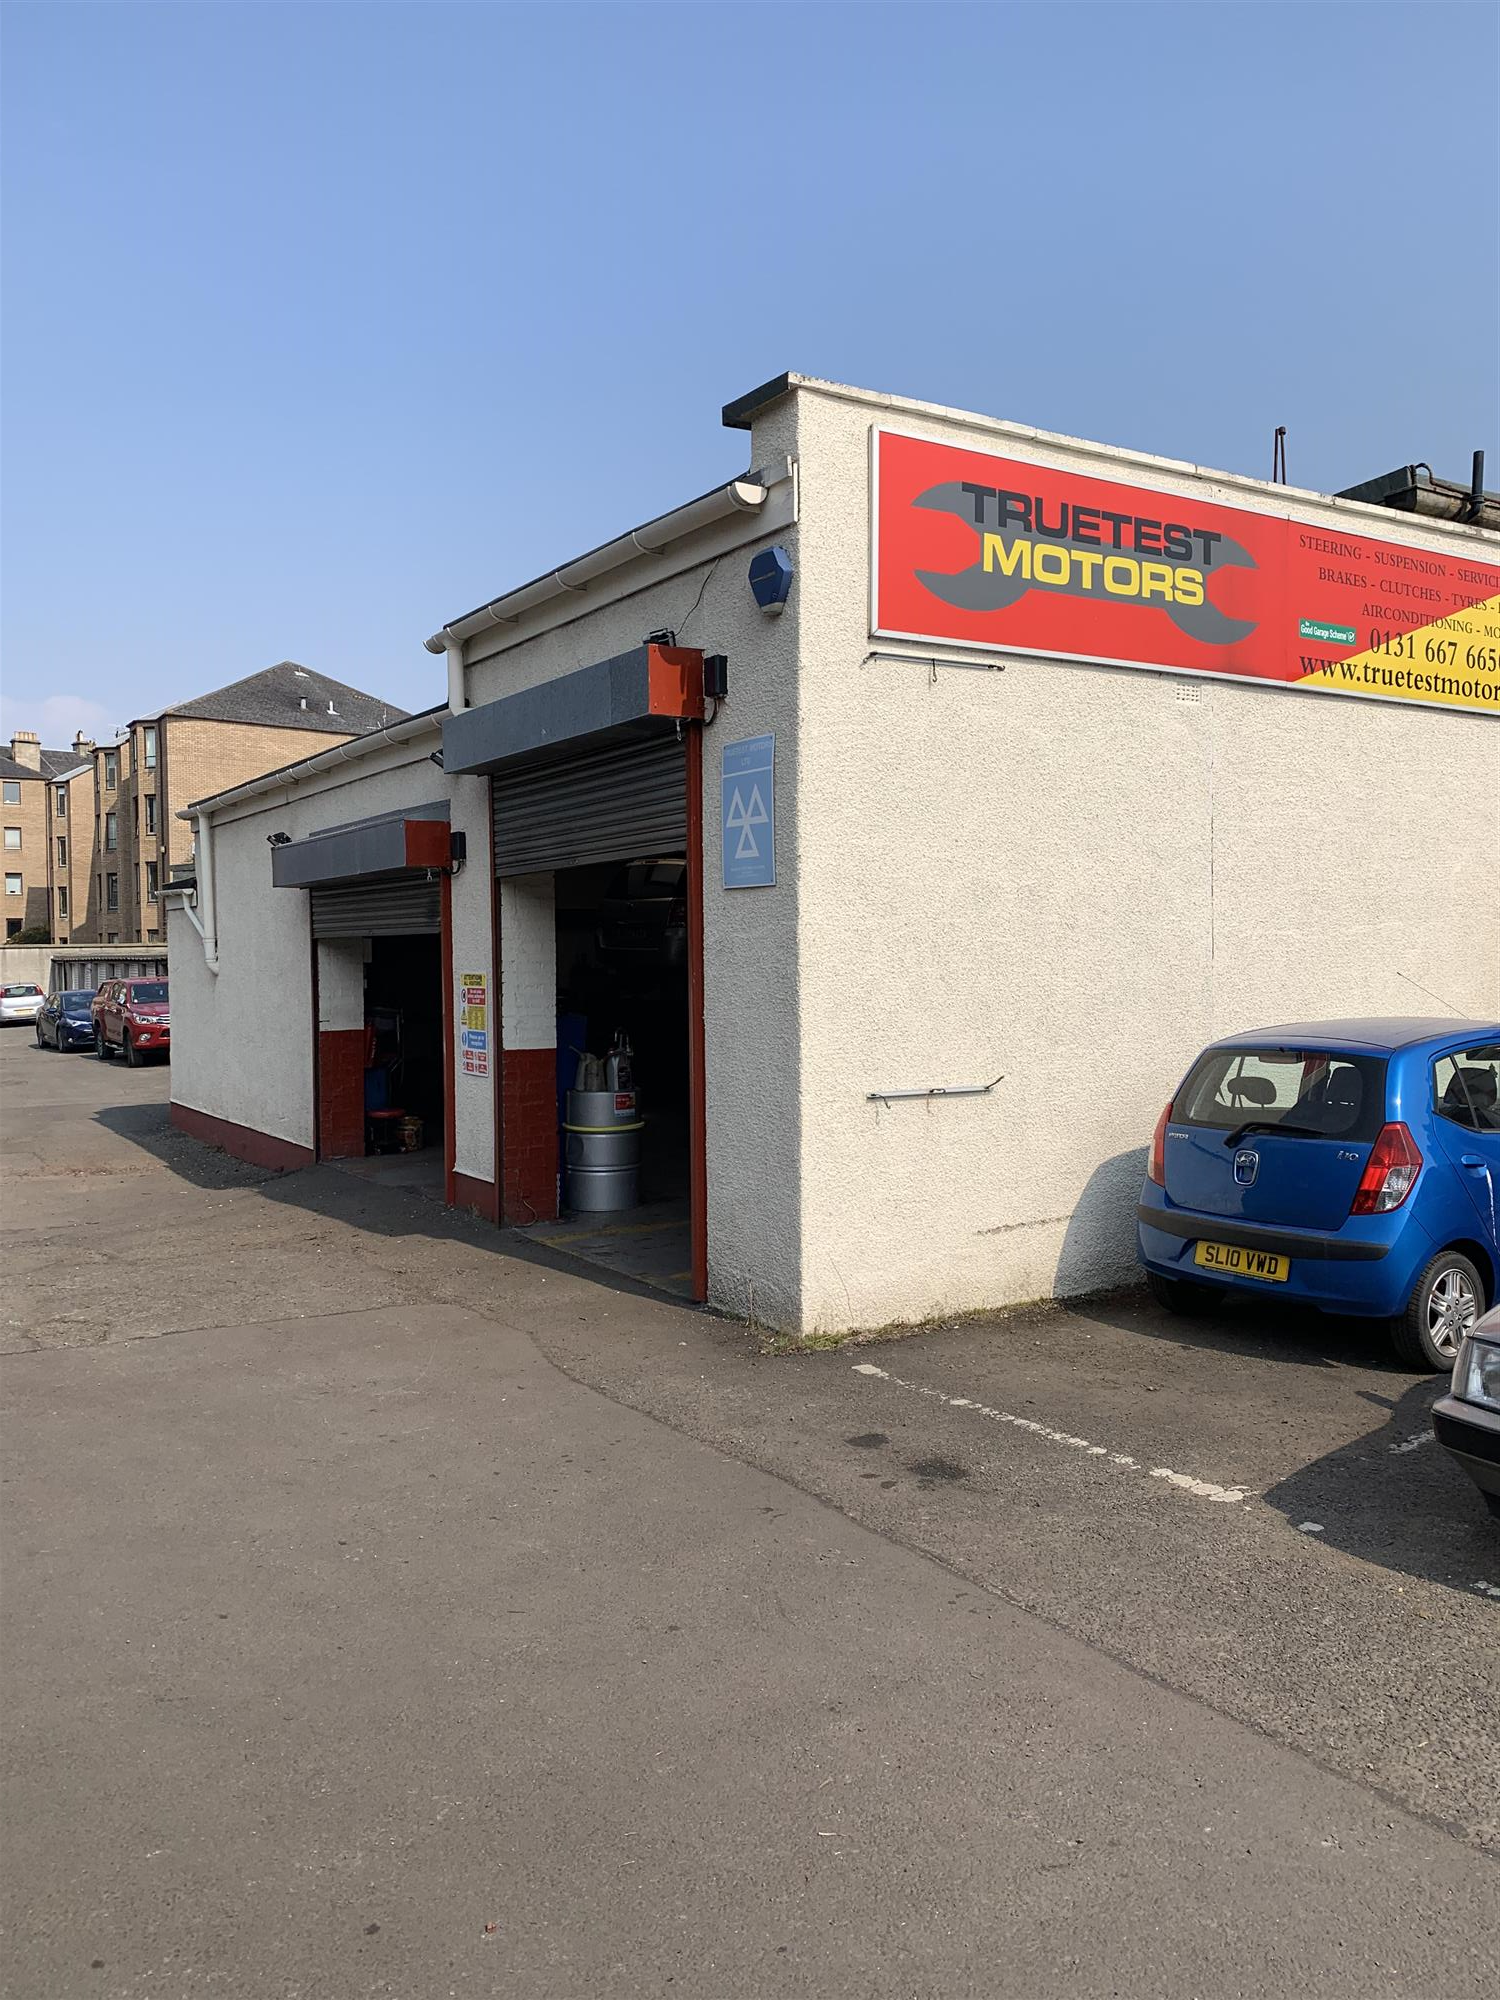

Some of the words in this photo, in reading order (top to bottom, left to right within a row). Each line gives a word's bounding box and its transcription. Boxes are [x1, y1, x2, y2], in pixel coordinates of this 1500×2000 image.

[962, 481, 1221, 565] TRUETEST
[983, 532, 1204, 606] MOTORS
[1300, 534, 1362, 560] STEERING
[1374, 550, 1446, 577] SUSPENSION
[1318, 567, 1367, 588] BRAKES
[1380, 579, 1441, 602] CLUTCHES
[1451, 592, 1487, 611] TYRES
[1301, 623, 1313, 635] Good
[1314, 626, 1329, 640] Garage
[1329, 629, 1347, 641] Scheme
[1362, 602, 1473, 634] AIRCONDITIONING
[1370, 627, 1415, 660] 0131
[1425, 638, 1458, 666] 667
[1466, 645, 1500, 673] 665
[1205, 1245, 1241, 1267] SL10
[1245, 1252, 1279, 1275] VWD
